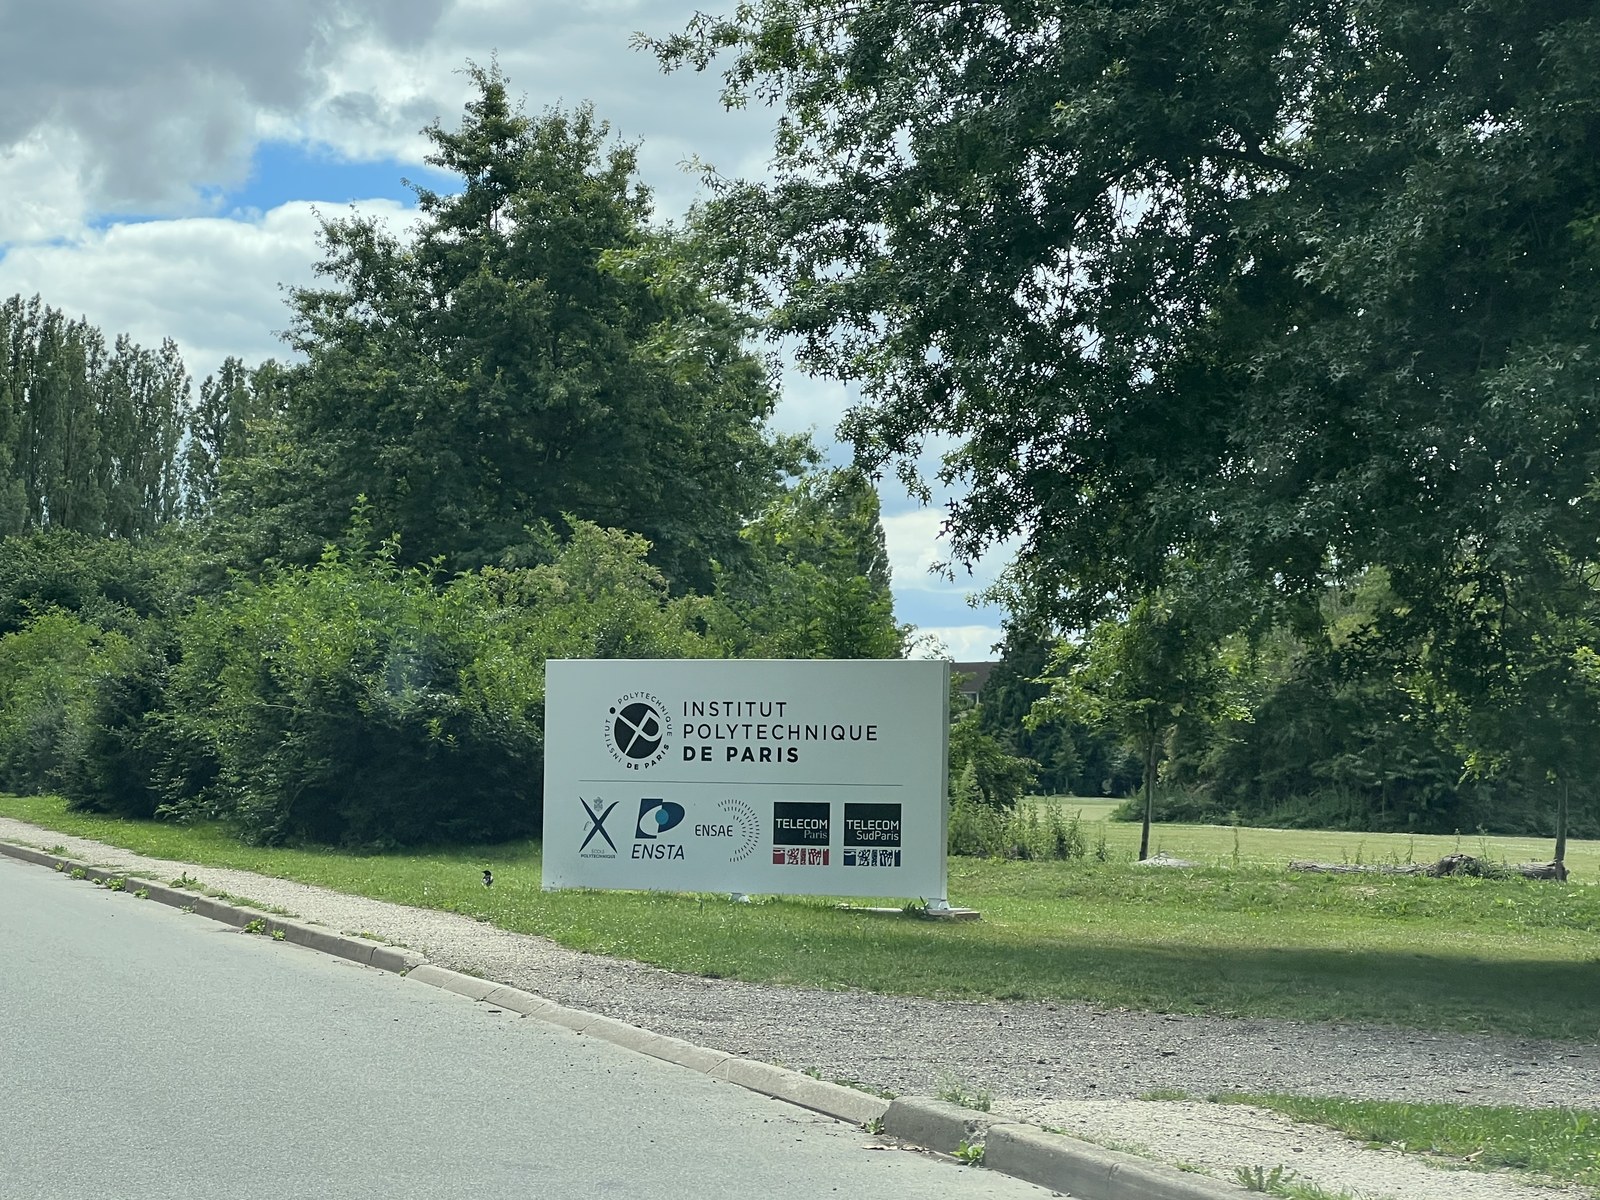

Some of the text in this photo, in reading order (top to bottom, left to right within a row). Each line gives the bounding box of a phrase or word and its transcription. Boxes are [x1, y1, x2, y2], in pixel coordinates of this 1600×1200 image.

[617, 691, 673, 737] POLYTECHNIQUE
[683, 701, 787, 718] INSTITUT
[604, 718, 622, 763] INSTITUT
[683, 723, 878, 741] POLYTECHNIQUE
[626, 743, 670, 771] DE PARIS
[683, 746, 799, 763] DE PARIS
[695, 824, 734, 837] ENSAE
[775, 818, 828, 829] TELECOM
[846, 820, 899, 830] TELECOM
[804, 830, 828, 839] Paris
[856, 830, 899, 841] SudParis
[631, 843, 685, 861] ENSTA
